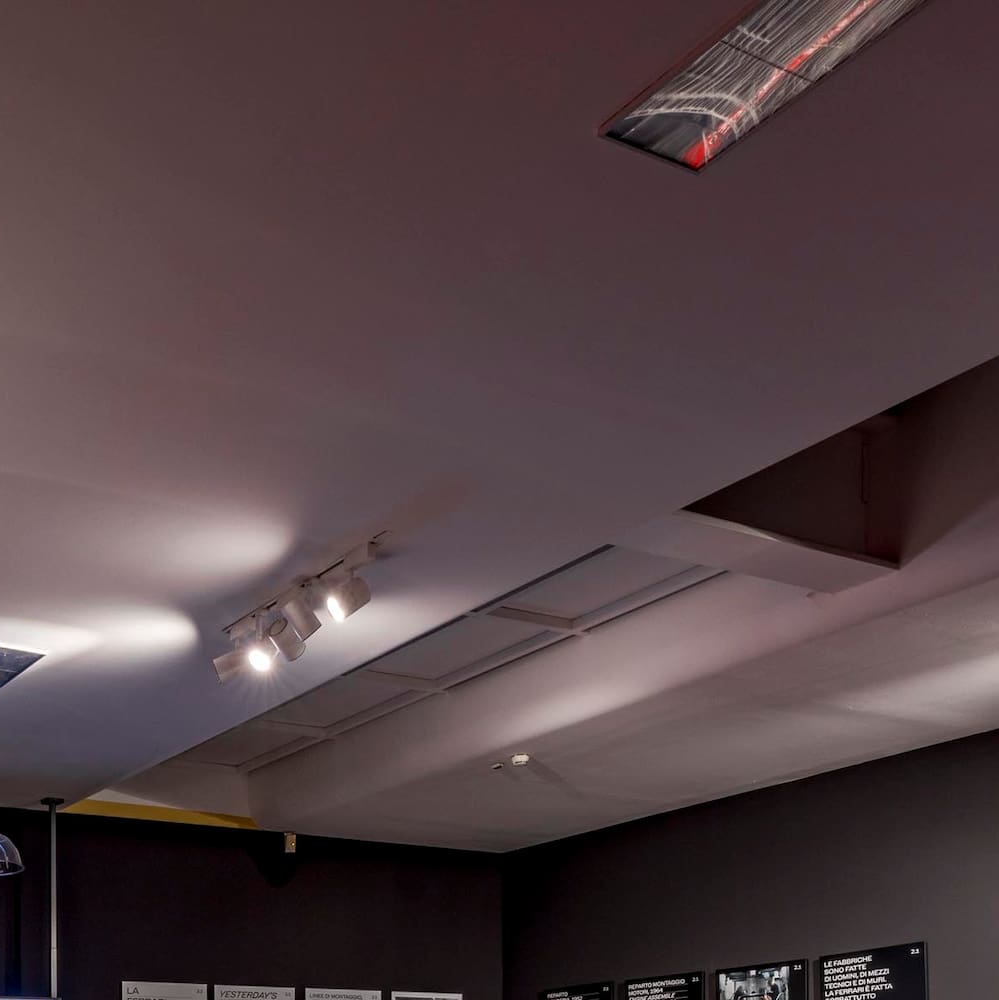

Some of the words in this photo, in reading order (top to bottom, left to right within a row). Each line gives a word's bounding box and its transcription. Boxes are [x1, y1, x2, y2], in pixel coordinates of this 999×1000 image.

[833, 955, 872, 967] FABBRICHE
[824, 967, 844, 975] SONO
[845, 963, 867, 973] FATTE
[832, 973, 859, 981] UOMINI,
[868, 968, 890, 977] MEZZI
[653, 979, 685, 987] MONTAGGIO
[824, 981, 852, 990] TECNICI
[127, 987, 139, 995] LA
[835, 987, 865, 996] FERRARI
[865, 984, 870, 992] È
[871, 983, 893, 991] FATTA
[220, 991, 278, 1000] YESTERDAY'S
